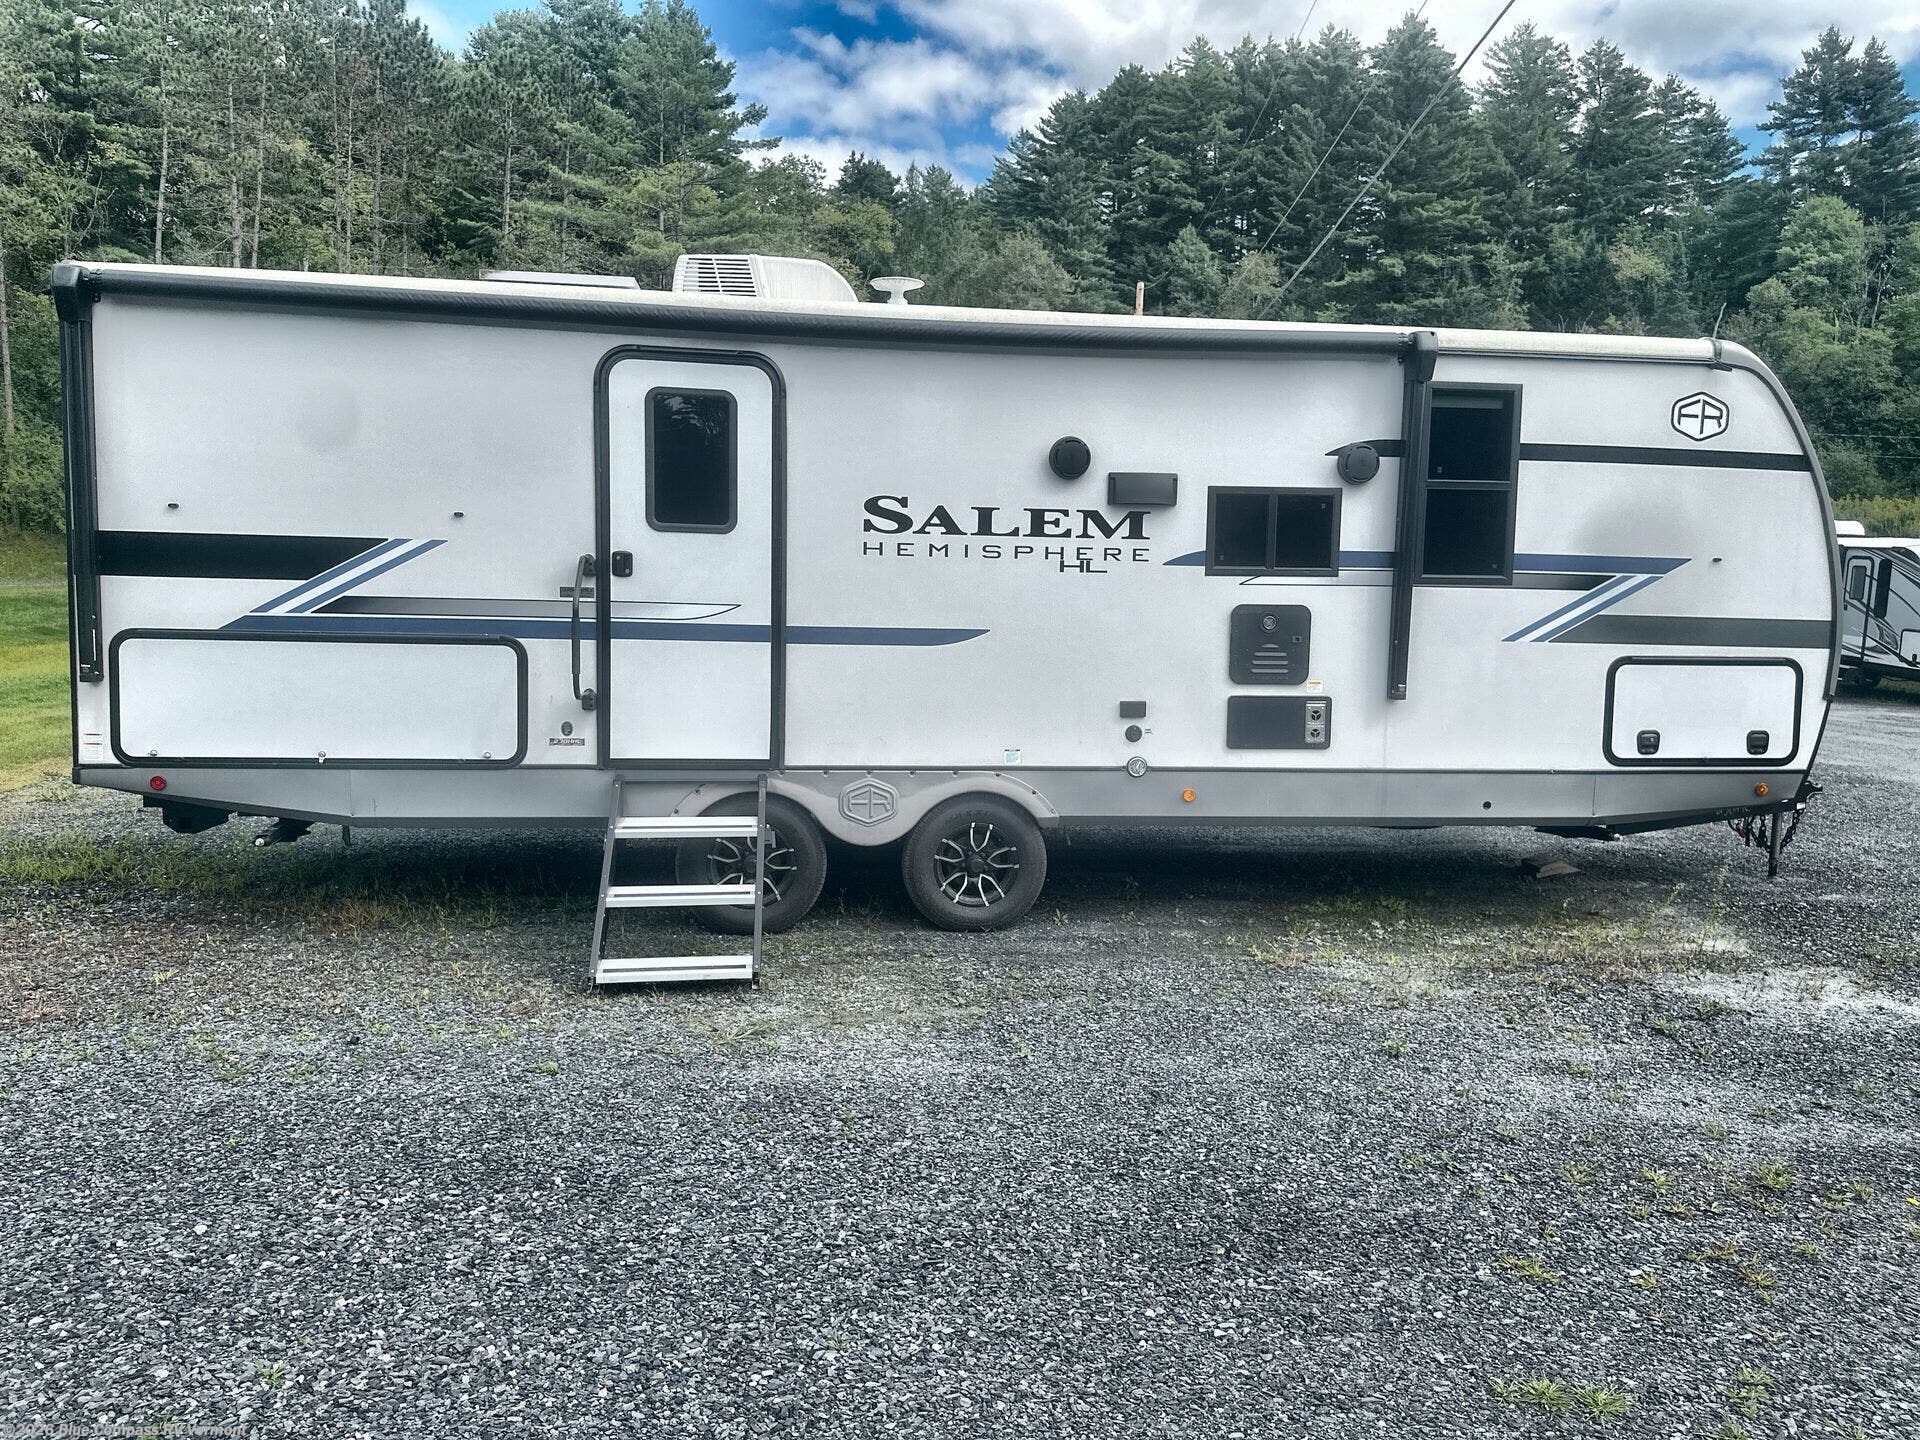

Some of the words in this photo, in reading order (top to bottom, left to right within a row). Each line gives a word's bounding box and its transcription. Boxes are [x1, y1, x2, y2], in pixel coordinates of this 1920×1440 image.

[863, 495, 1151, 540] SALEM
[863, 541, 1150, 562] HEMISPHERE
[1059, 559, 1108, 573] HL
